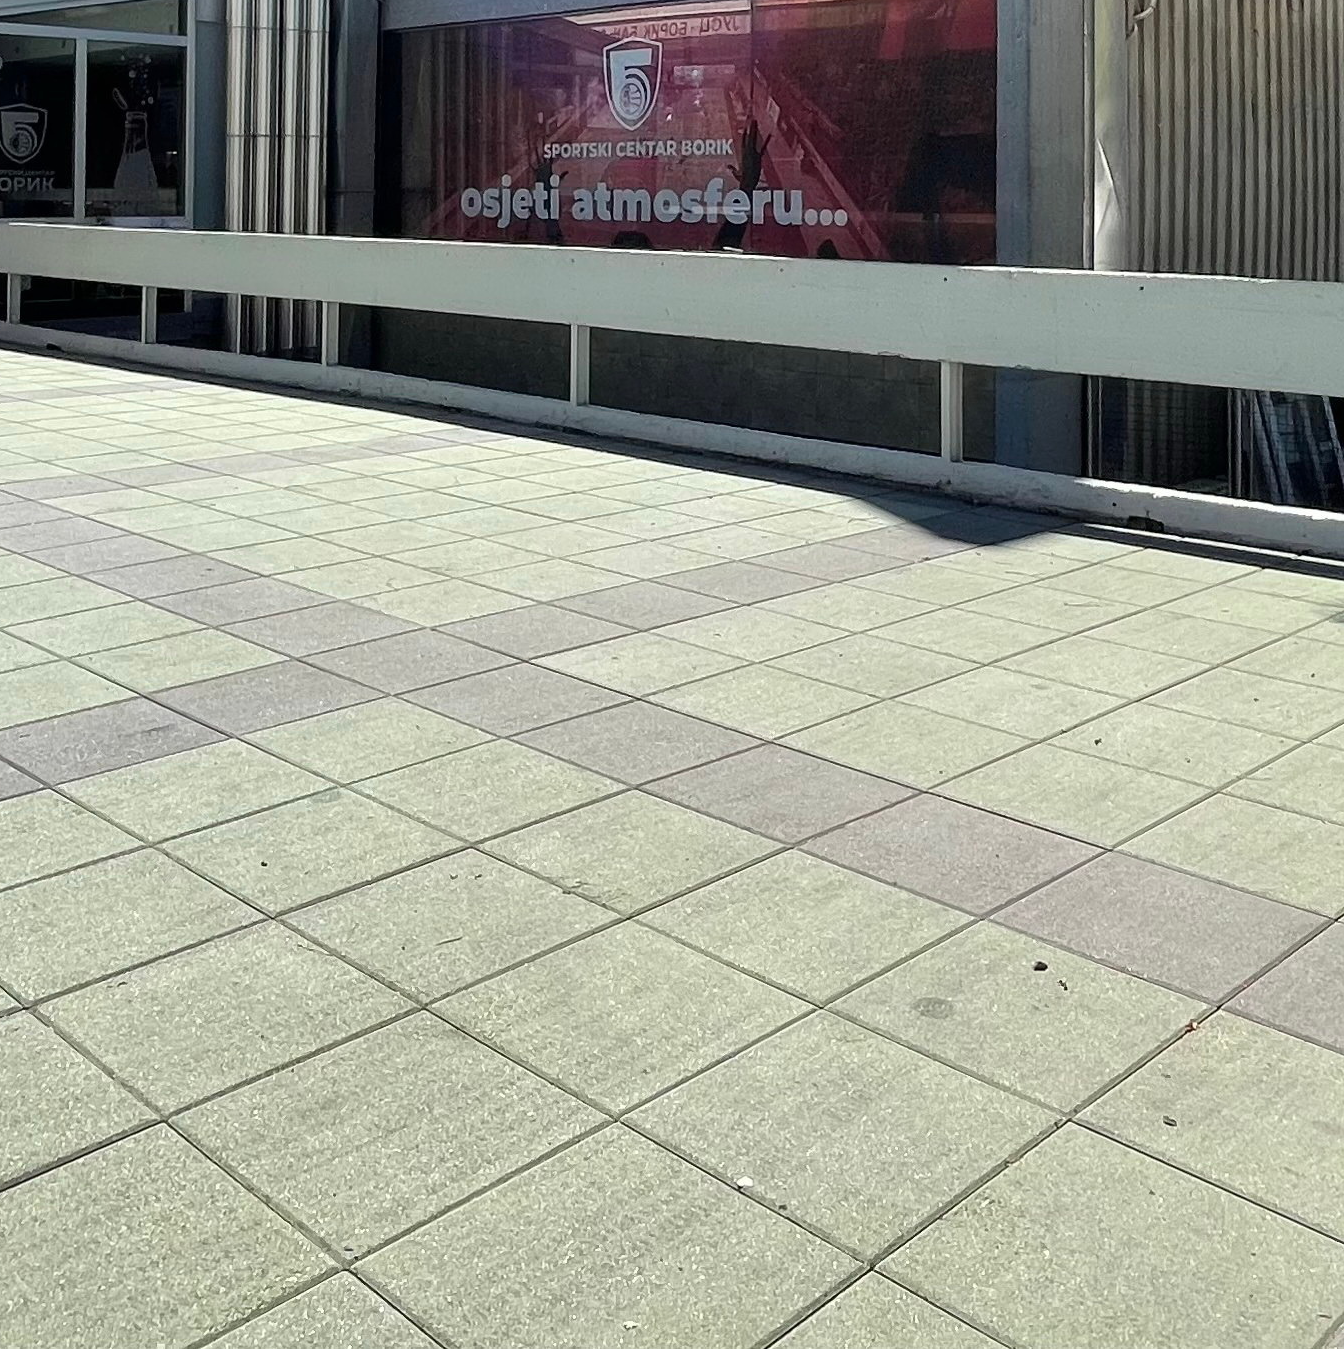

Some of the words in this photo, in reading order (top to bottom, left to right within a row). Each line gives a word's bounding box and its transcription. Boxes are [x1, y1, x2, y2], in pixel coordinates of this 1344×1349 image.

[543, 142, 612, 159] SPORTSKI
[615, 141, 678, 158] CENTAR
[682, 138, 734, 157] BORIK
[460, 174, 560, 229] osjeti
[571, 178, 848, 227] atmosferu...
